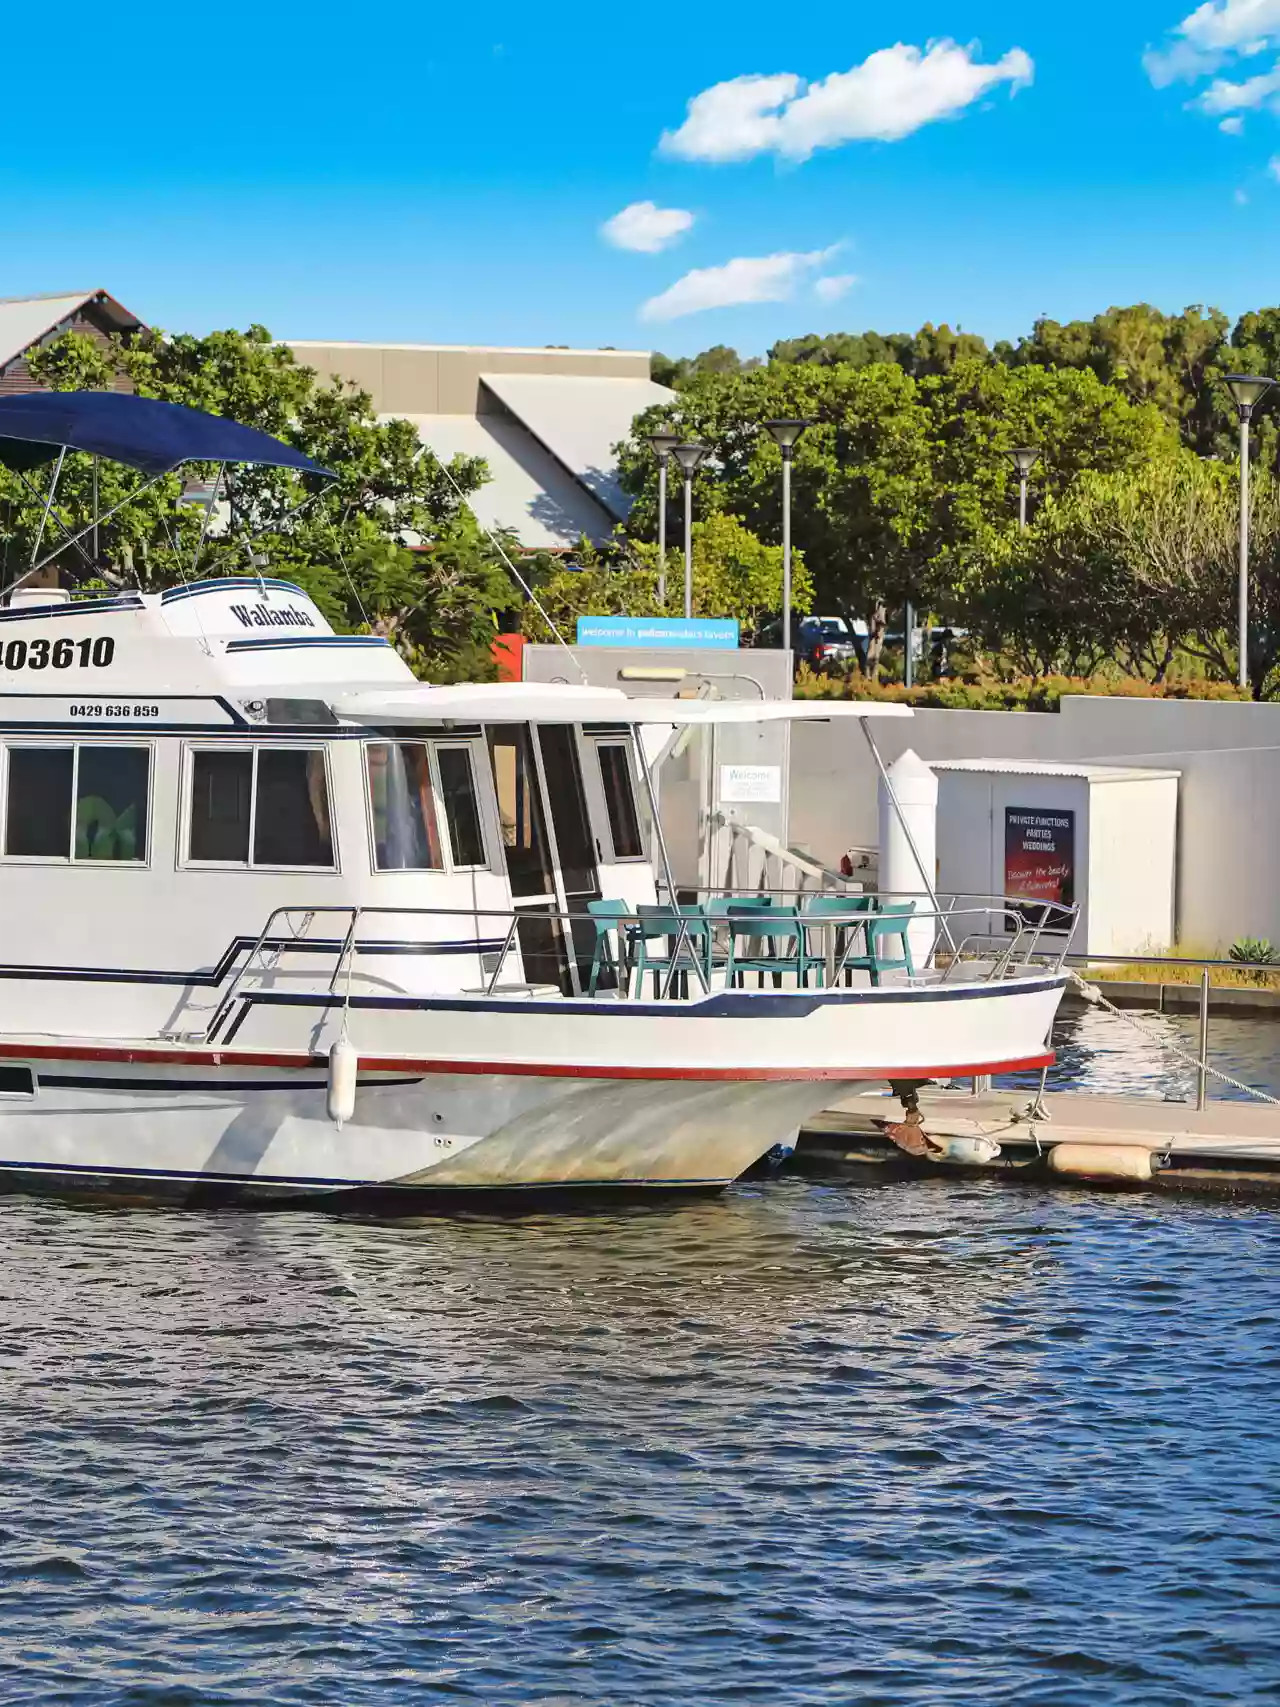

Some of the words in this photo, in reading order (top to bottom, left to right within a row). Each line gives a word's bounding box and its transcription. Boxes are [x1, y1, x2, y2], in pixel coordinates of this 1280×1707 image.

[230, 604, 315, 627] Wallamba
[70, 705, 102, 717] 0429
[105, 705, 130, 717] 636
[133, 705, 159, 717] 859
[1009, 815, 1034, 825] PRIVATE
[1035, 816, 1069, 828] FUNCTIONS
[1026, 828, 1052, 839] PARTIES
[1023, 841, 1056, 852] WEDDINGS
